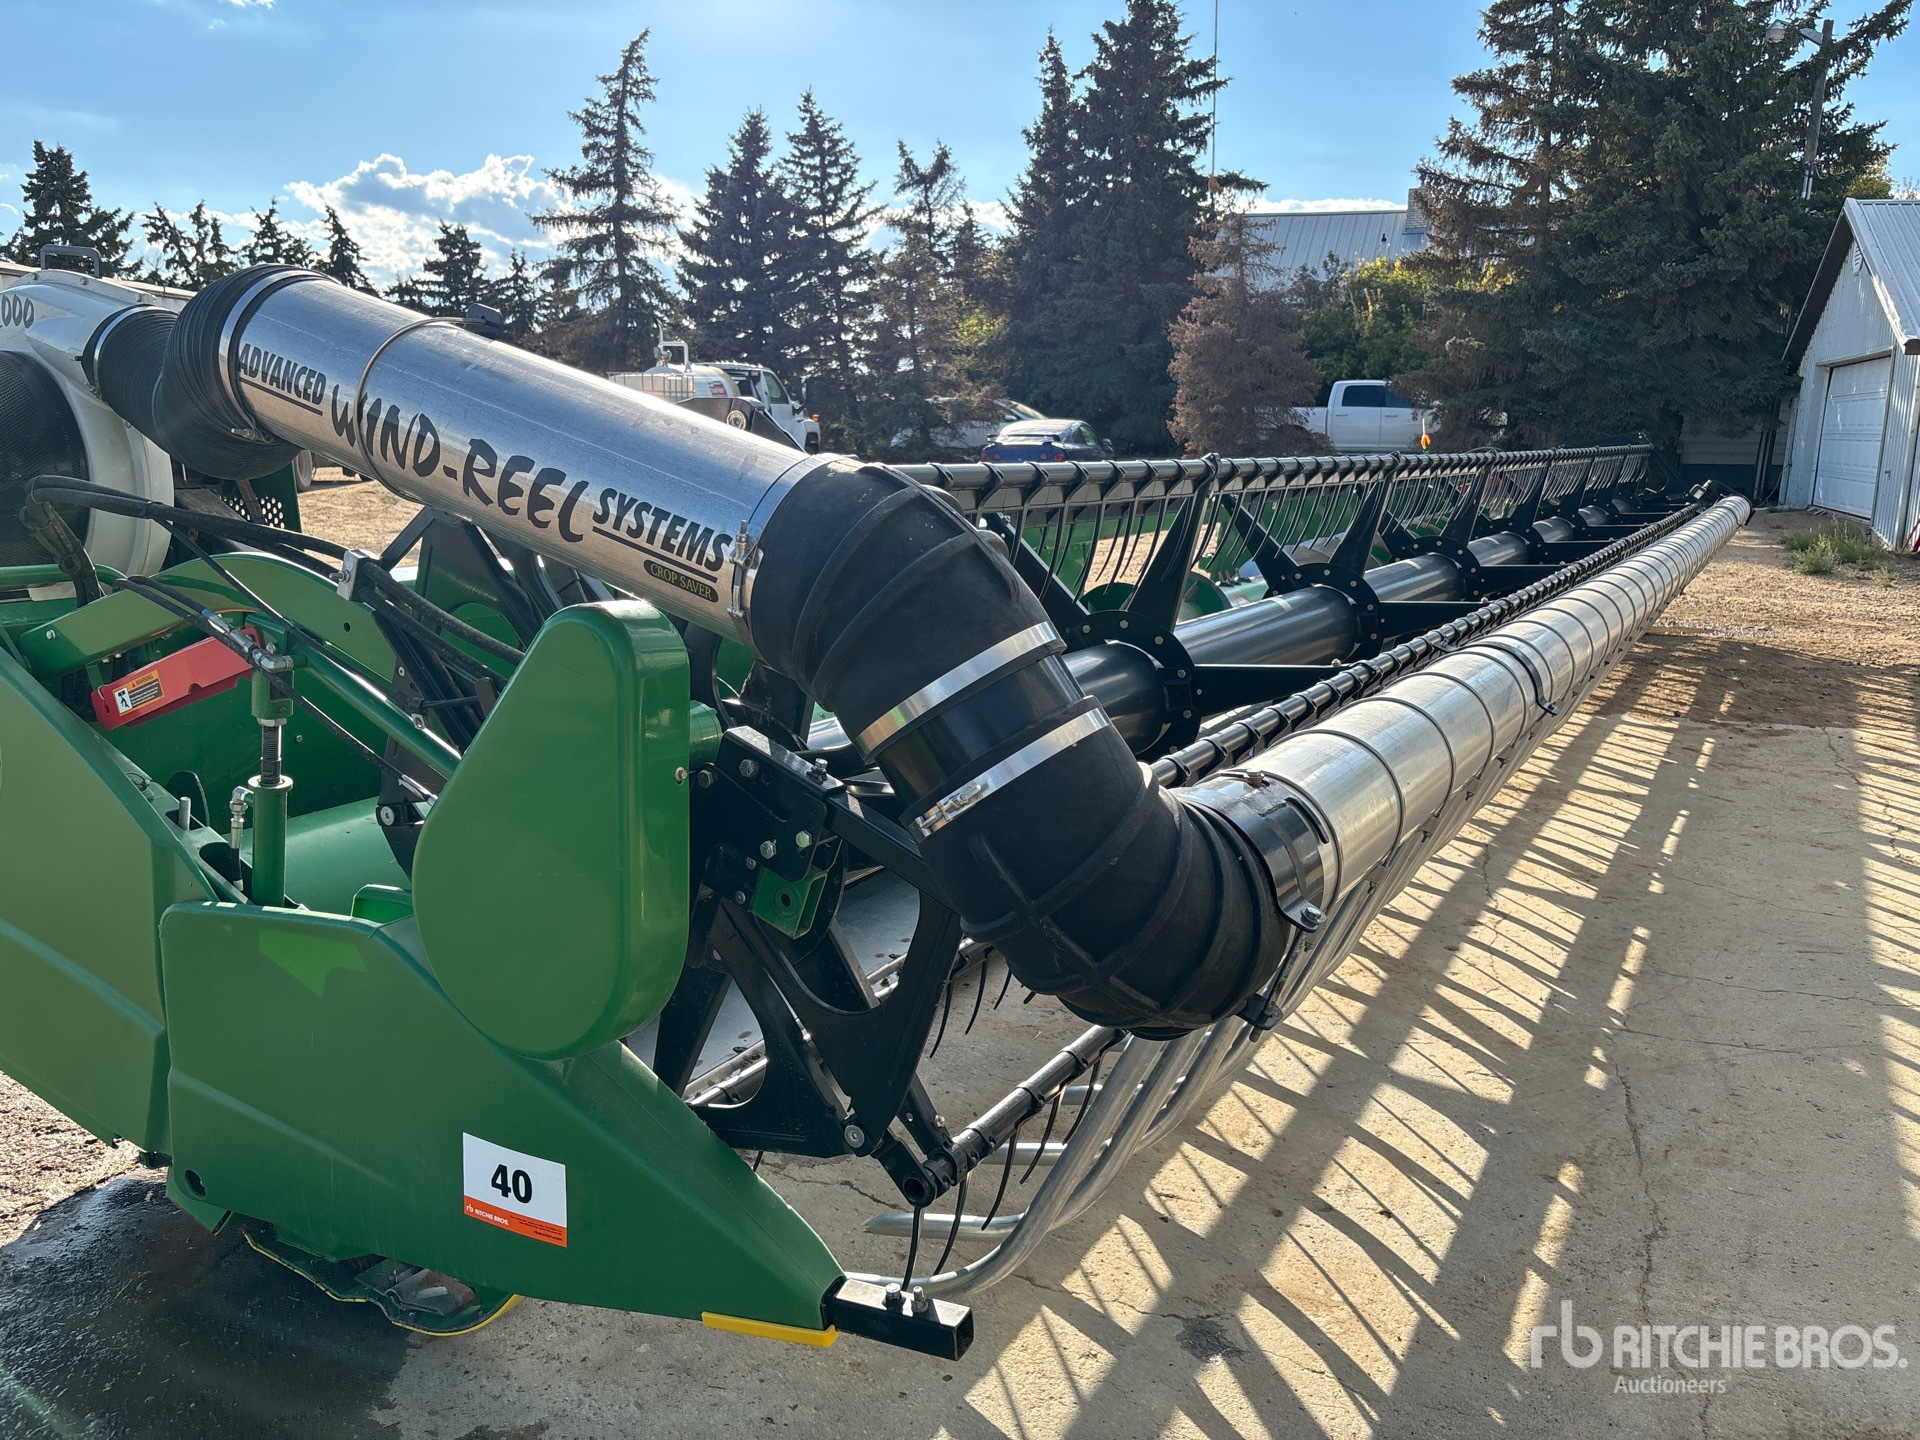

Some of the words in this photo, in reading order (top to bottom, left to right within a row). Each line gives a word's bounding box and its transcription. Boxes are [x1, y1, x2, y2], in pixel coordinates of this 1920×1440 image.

[0, 294, 34, 329] 000
[238, 343, 327, 405] ADVANCED
[331, 384, 589, 543] WIND-REEL
[592, 488, 733, 572] SYSTEMS
[650, 563, 677, 584] CROP
[679, 576, 713, 600] SAVER
[135, 674, 153, 686] WARNING
[490, 1163, 533, 1204] 40
[475, 1208, 493, 1220] RITCHIE
